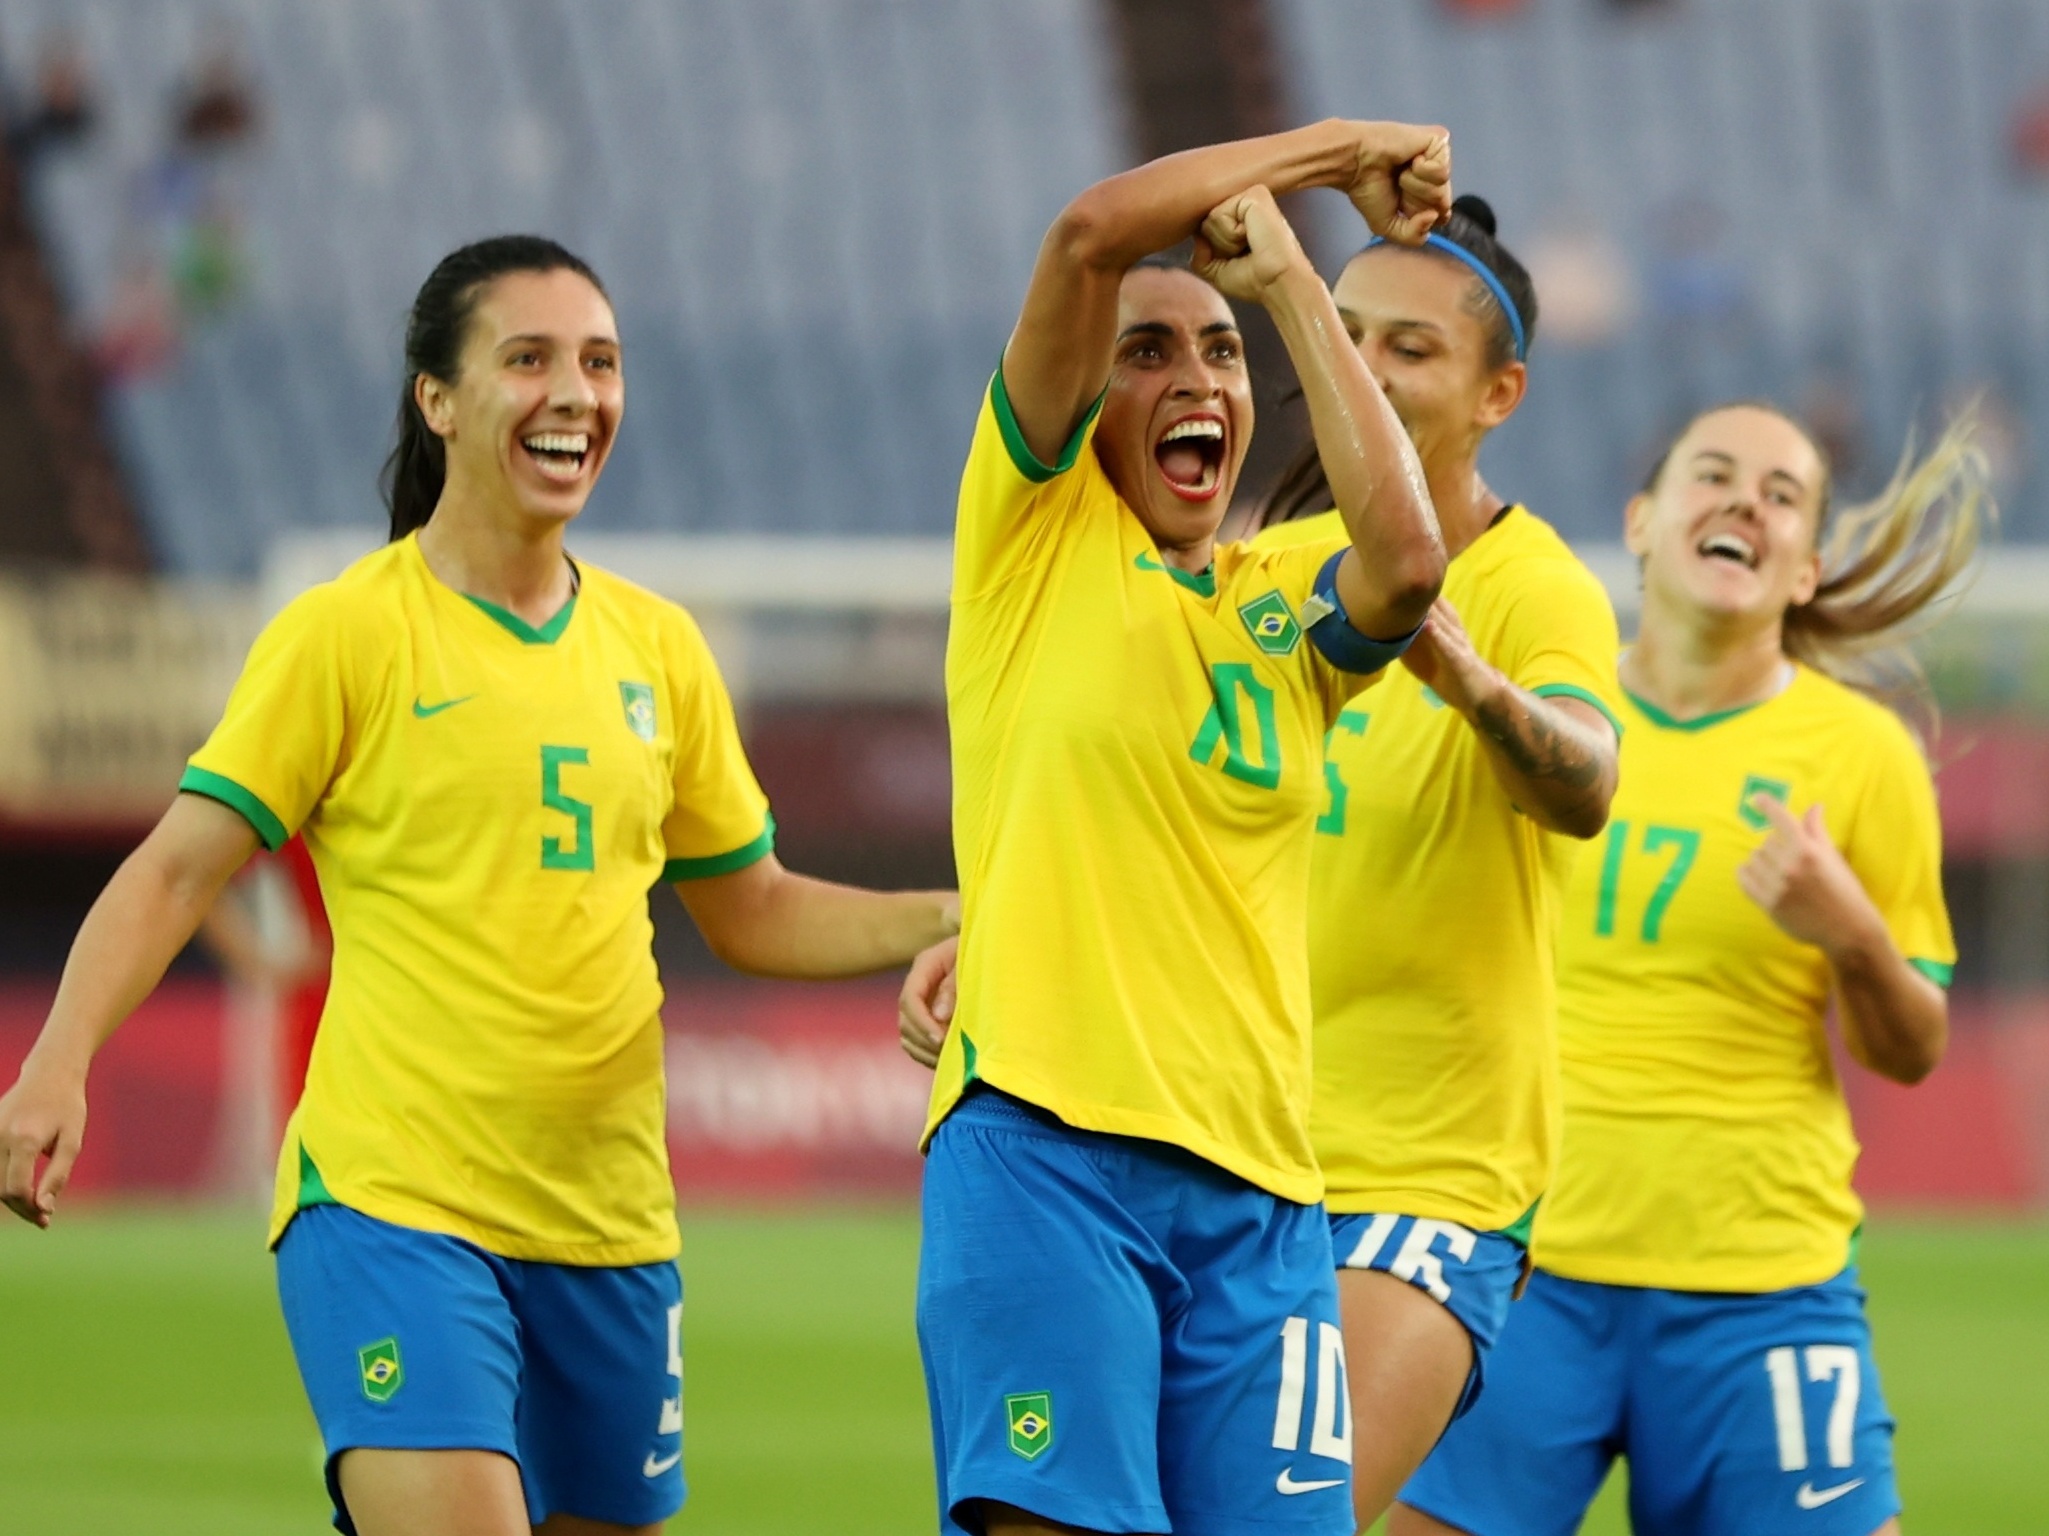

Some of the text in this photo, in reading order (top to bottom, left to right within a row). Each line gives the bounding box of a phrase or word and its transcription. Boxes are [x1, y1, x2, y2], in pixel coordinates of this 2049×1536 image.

[1188, 662, 1282, 791] 10
[541, 745, 595, 870] 5
[1596, 821, 1699, 941] 17
[1272, 1316, 1353, 1465] 10
[1765, 1344, 1860, 1472] 17
